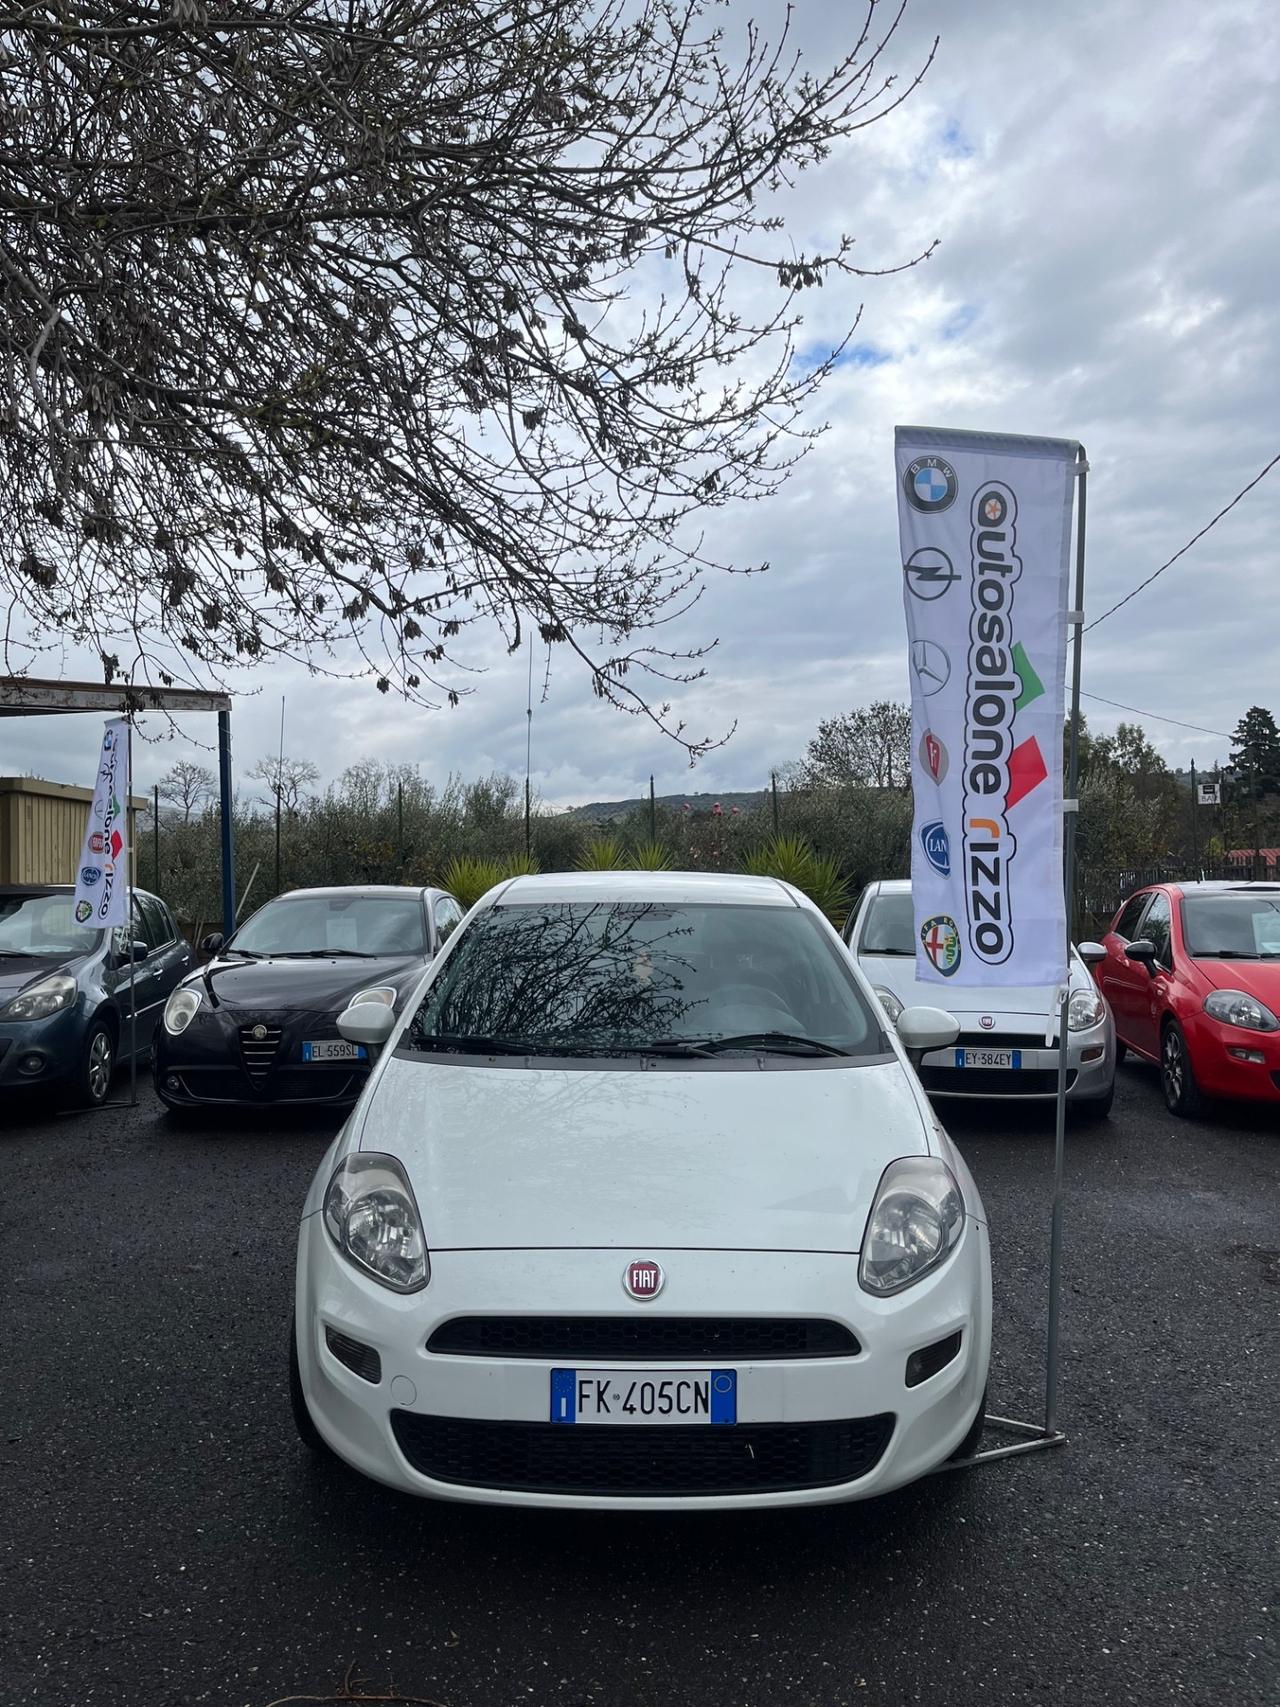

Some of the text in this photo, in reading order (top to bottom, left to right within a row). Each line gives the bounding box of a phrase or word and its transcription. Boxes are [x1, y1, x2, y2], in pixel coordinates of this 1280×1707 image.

[911, 458, 953, 478] BMW
[969, 491, 1016, 955] autosalone rizzo
[312, 1045, 325, 1058] EL
[965, 1052, 1012, 1066] EY 384EY
[632, 1269, 657, 1289] FIAT
[577, 1379, 710, 1415] FK 405CN
